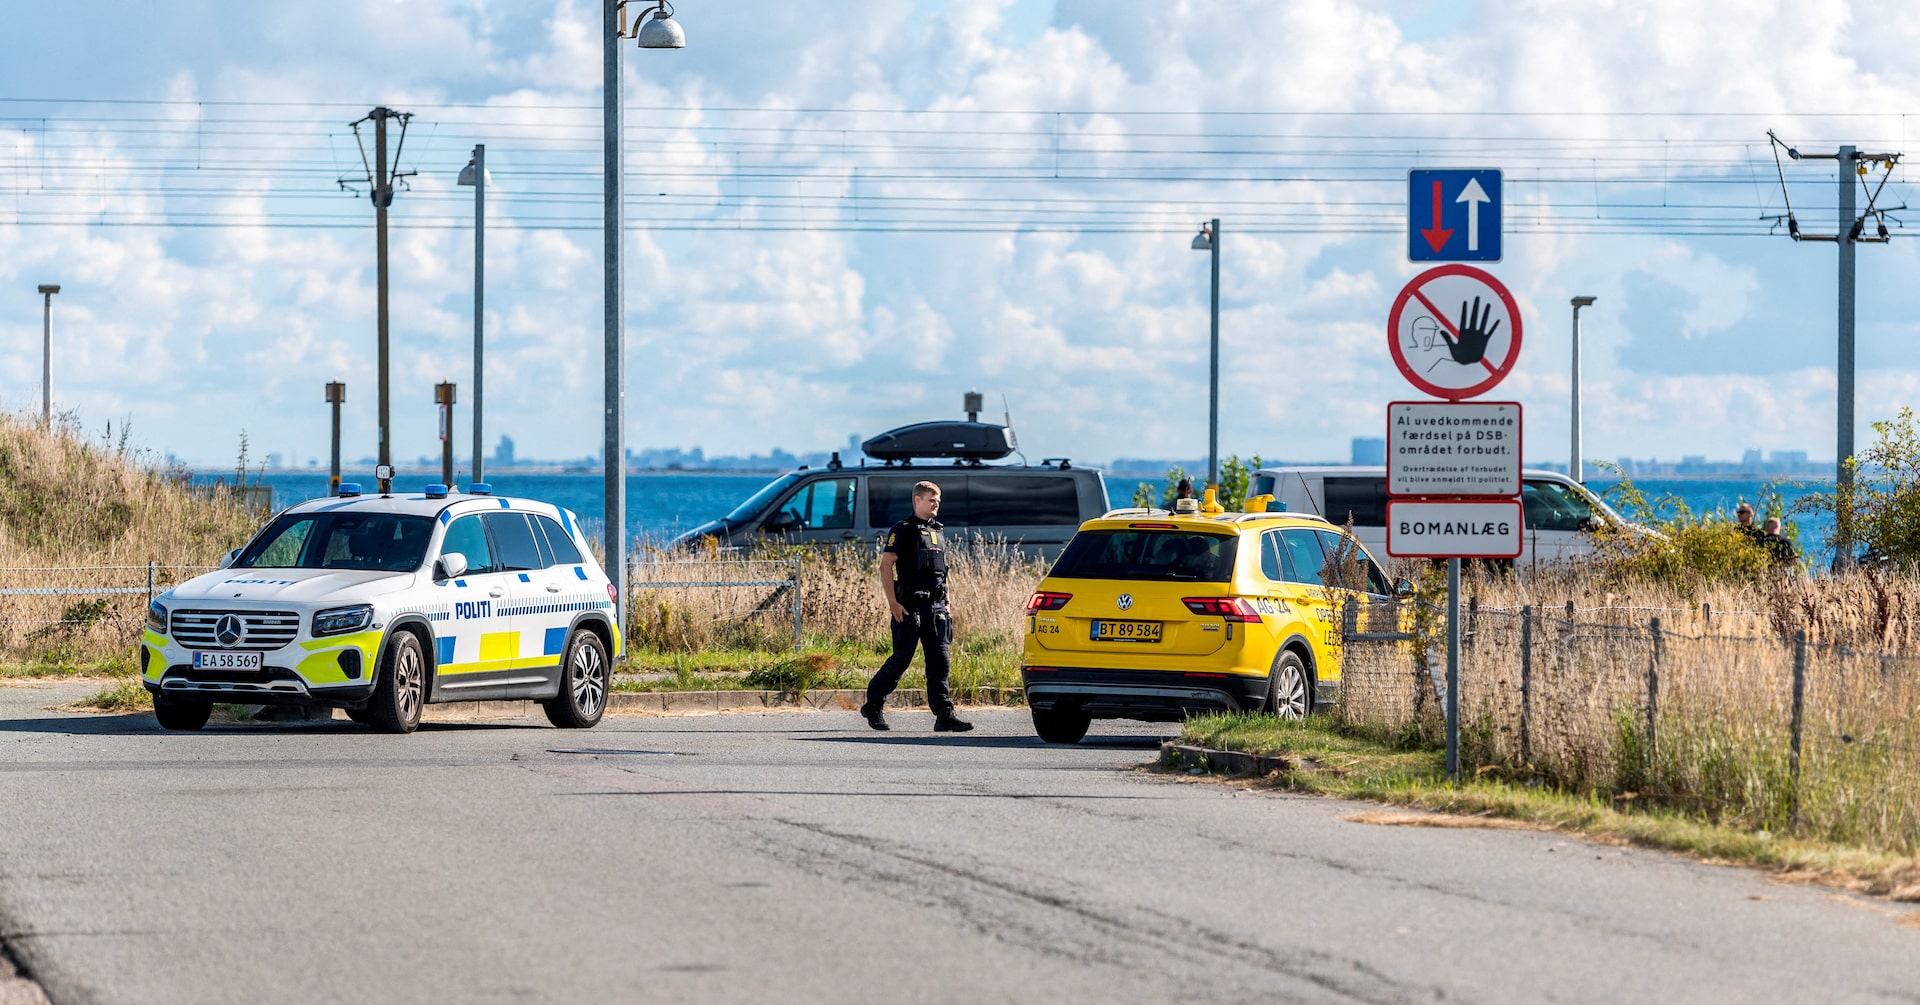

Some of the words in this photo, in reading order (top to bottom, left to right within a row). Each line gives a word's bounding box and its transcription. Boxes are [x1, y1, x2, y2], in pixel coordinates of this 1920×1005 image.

[1397, 416, 1411, 426] Al
[1415, 416, 1513, 426] uvedkommende
[1403, 430, 1452, 440] færdsel
[1457, 430, 1471, 442] på
[1476, 431, 1508, 440] DSB-
[1400, 445, 1452, 455] området
[1457, 445, 1511, 455] forbudt.
[1402, 465, 1458, 473] Overtrædelse
[1460, 465, 1469, 473] af
[1471, 465, 1507, 473] forbudet
[1400, 522, 1510, 535] BOMANLÆG
[455, 600, 491, 620] POLITI
[1256, 597, 1274, 614] AG
[1274, 597, 1292, 615] 24
[1038, 624, 1047, 633] AG
[1050, 625, 1060, 634] 24
[1100, 623, 1116, 635] BT
[1119, 623, 1134, 636] 89
[1136, 624, 1160, 637] 584
[202, 654, 217, 667] EA
[220, 655, 234, 667] 58
[236, 655, 258, 668] 569
